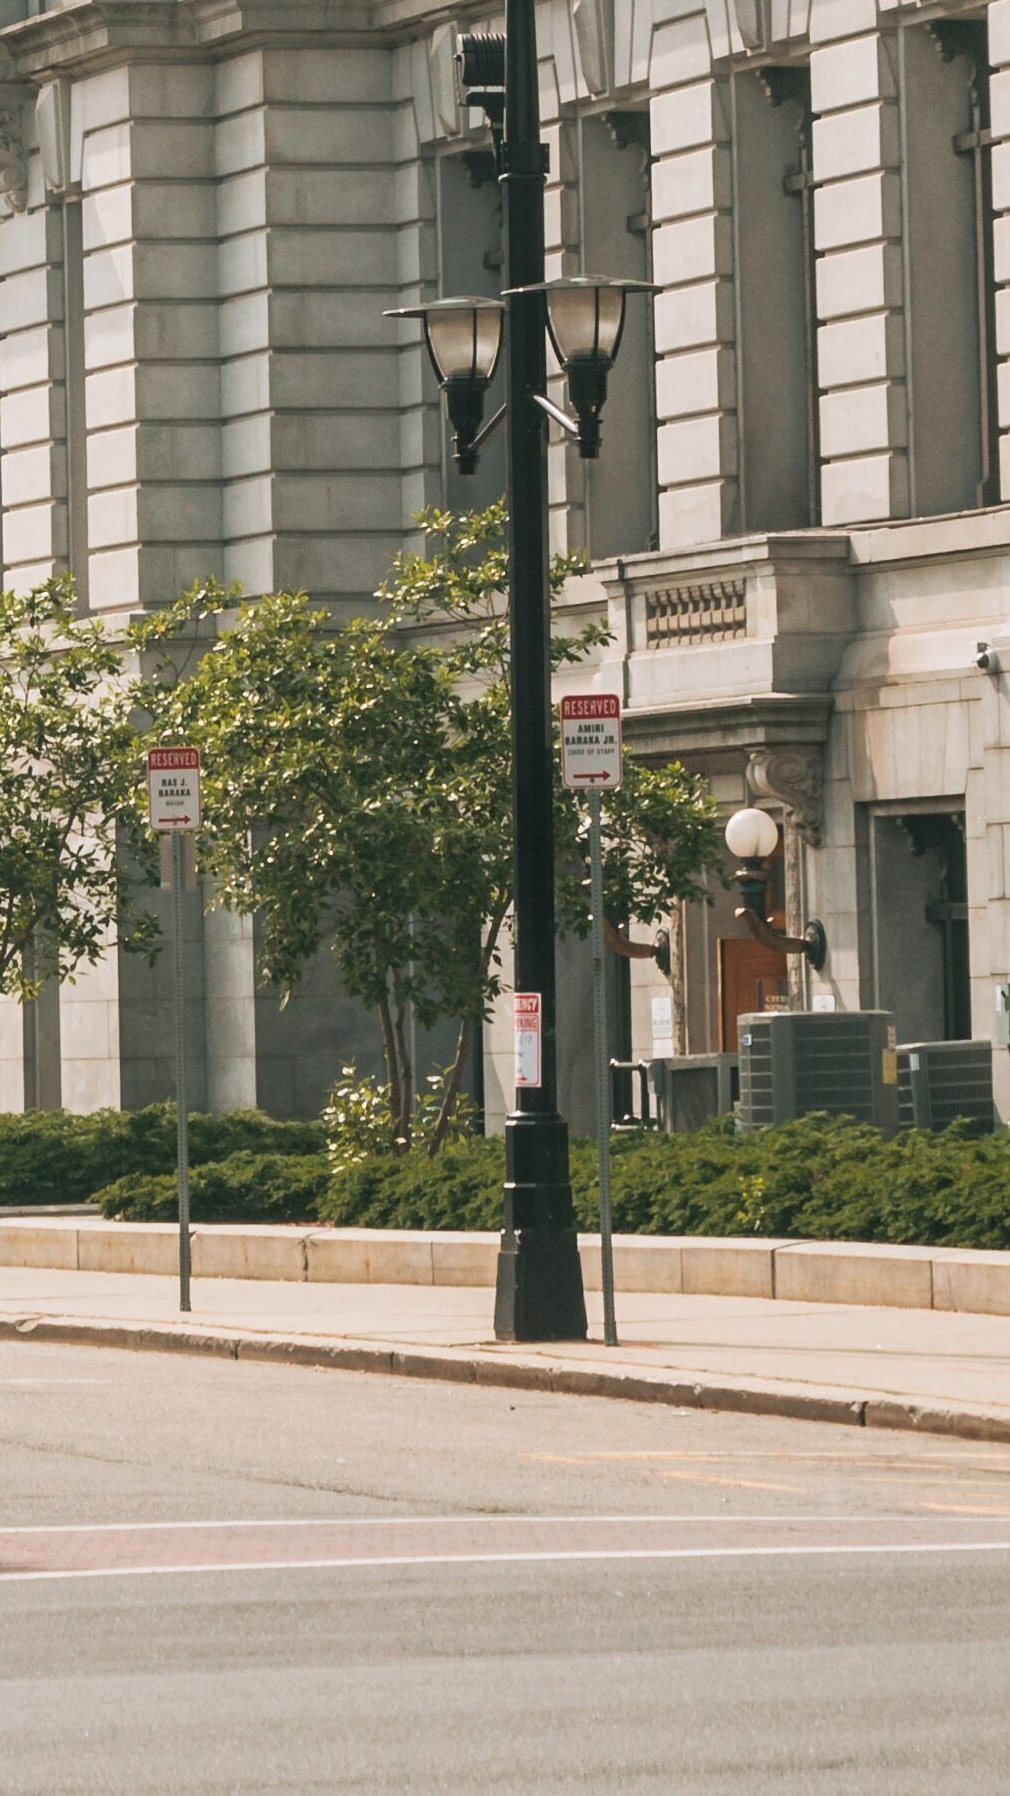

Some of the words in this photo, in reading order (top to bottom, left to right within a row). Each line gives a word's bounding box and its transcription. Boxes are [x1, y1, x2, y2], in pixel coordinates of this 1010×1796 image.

[564, 699, 617, 716] RESERVED
[578, 724, 604, 733] AMIRI
[565, 736, 600, 745] BARAKA
[150, 753, 197, 766] RESERVED
[161, 778, 177, 787] RAS
[158, 789, 191, 797] BARAKA
